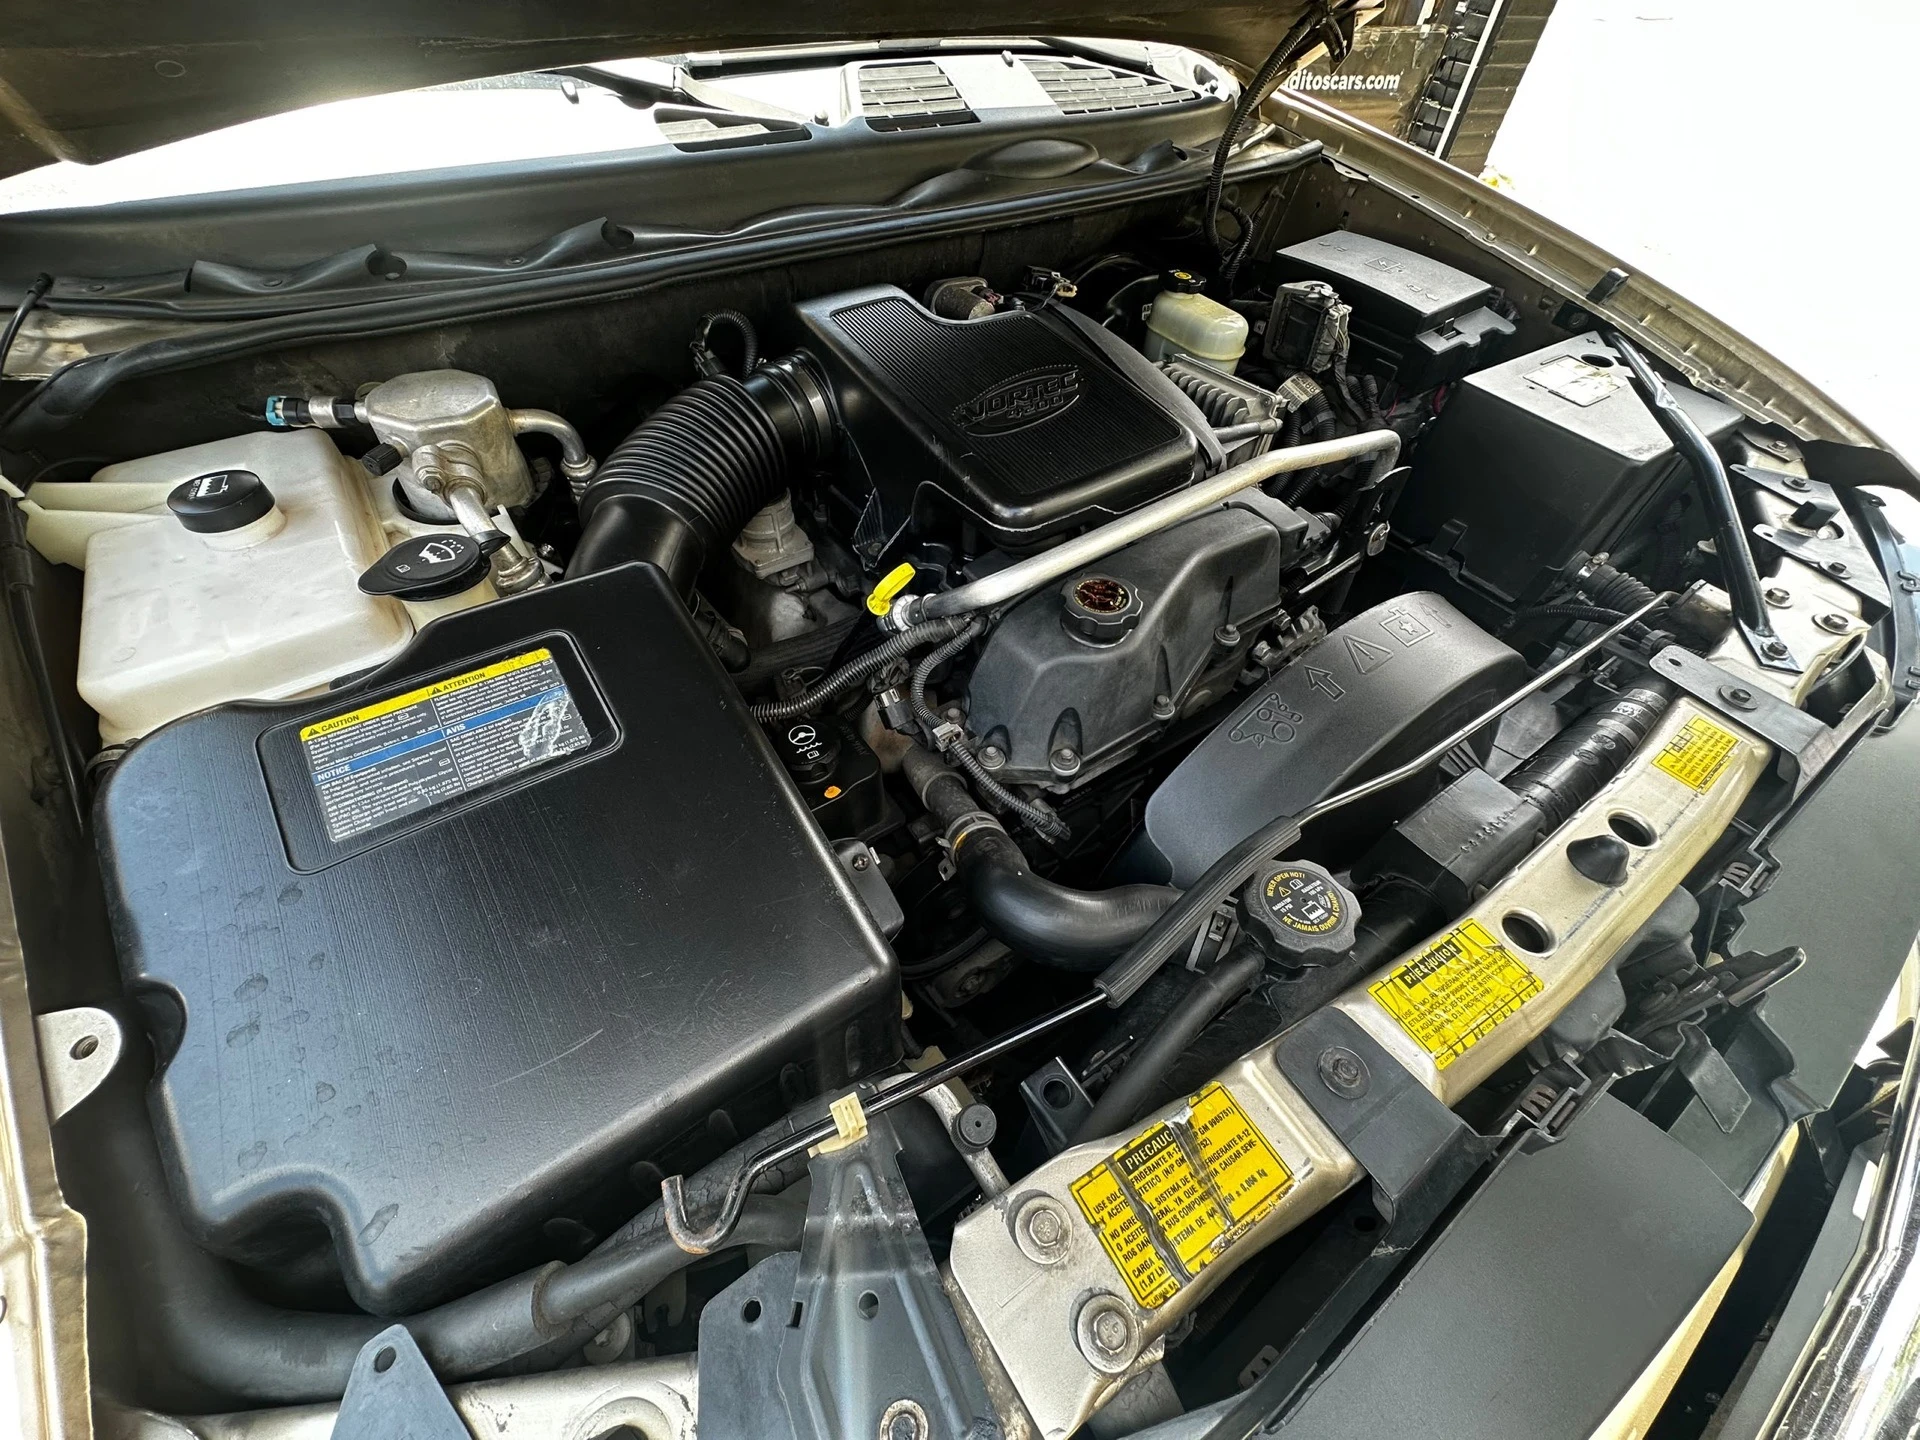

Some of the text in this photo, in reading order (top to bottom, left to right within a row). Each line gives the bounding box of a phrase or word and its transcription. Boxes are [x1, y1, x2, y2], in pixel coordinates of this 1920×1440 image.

[1286, 69, 1400, 91] ditoscars.com
[960, 373, 1079, 421] VORTEC
[442, 671, 486, 690] ATTENTION
[320, 714, 359, 732] CAUTION
[445, 722, 466, 735] AVIS
[317, 763, 351, 781] NOTICE
[1266, 877, 1278, 897] NEVER
[1275, 872, 1290, 882] OPEN
[1282, 916, 1293, 925] NE
[1292, 922, 1320, 932] JAMAIS
[1318, 915, 1337, 931] OUVRIR
[1124, 1127, 1176, 1170] PRECAUC
[1092, 1199, 1109, 1216] USE
[1129, 1154, 1169, 1187] FRIGERANTE
[1108, 1228, 1122, 1243] NO
[1153, 1180, 1182, 1207] SISTEMA
[1178, 1174, 1191, 1187] DE
[1203, 1135, 1239, 1167] FRIGERANTE
[1234, 1126, 1251, 1142] R-12
[1123, 1226, 1147, 1249] ACEITE
[1173, 1195, 1185, 1208] YA
[1183, 1184, 1199, 1200] QUE
[1218, 1149, 1243, 1172] CAUSAR
[1239, 1136, 1258, 1154] SEVE-
[1106, 1198, 1131, 1221] ACEITE
[1122, 1247, 1139, 1265] ROS
[1164, 1213, 1181, 1230] SUS
[1131, 1255, 1155, 1279] CARGA
[1194, 1214, 1207, 1228] DE
[1138, 1271, 1158, 1292] (1,87
